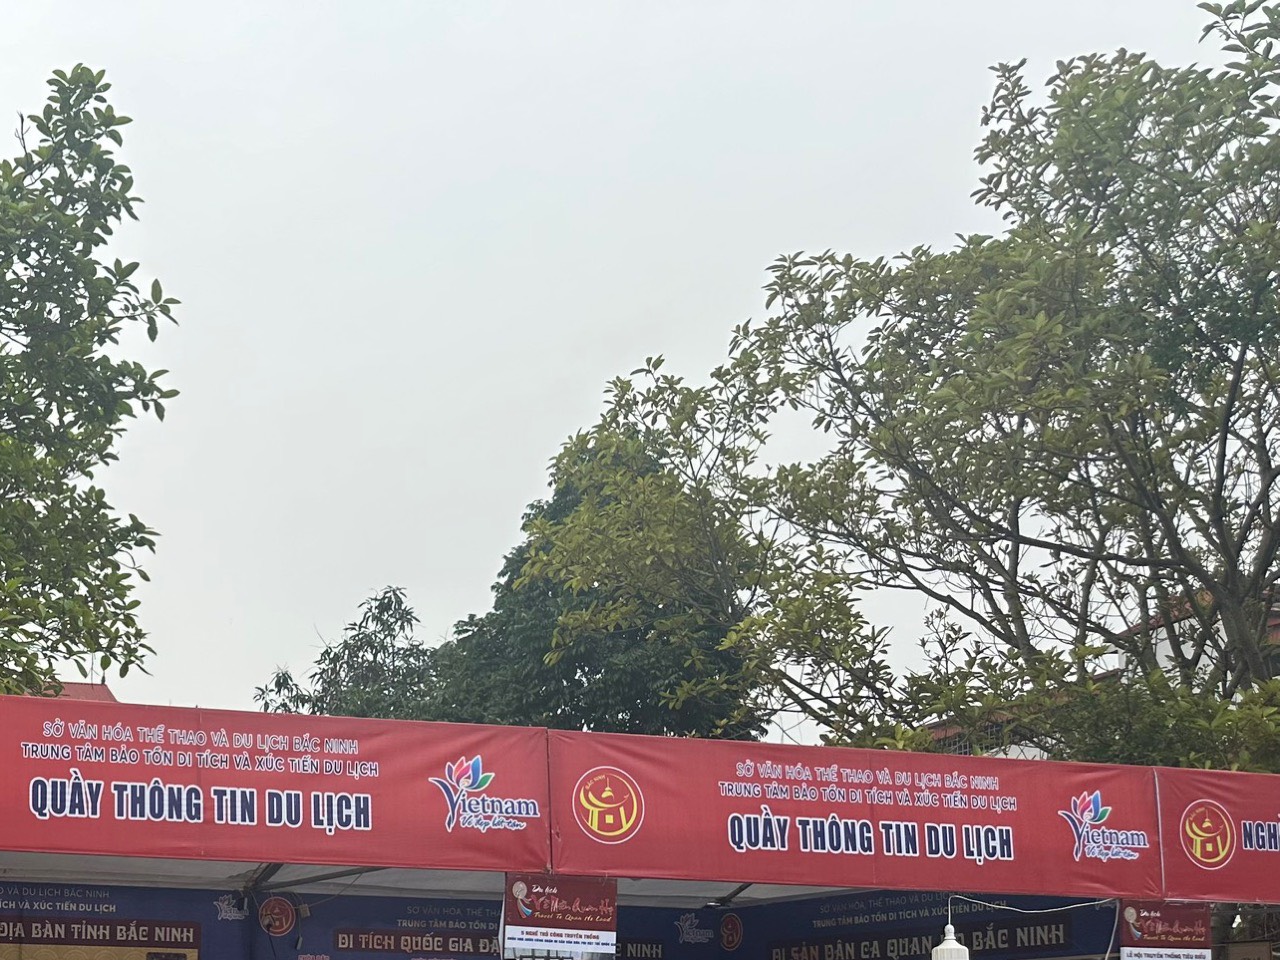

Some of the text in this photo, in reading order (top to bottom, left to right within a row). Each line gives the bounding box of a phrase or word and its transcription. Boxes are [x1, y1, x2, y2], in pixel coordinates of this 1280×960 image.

[43, 718, 359, 755] SỞ VĂN HÓA THỂ THAO VÀ DU LỊCH BẮC NINH
[21, 742, 379, 780] TRUNG TÂM BẢO TỒN DI TÍCH VÀ XÚC TIẾN DU LỊCH
[736, 759, 999, 791] SỞ VĂN HÓA THỂ THAO VÀ DU LỊCH BẮC NINH
[29, 768, 372, 835] QUẦY THÔNG TIN DU LỊCH
[428, 777, 540, 832] Vietnam
[719, 780, 1017, 814] TRUNG TÂM BẢO TỒN DI TÍCH VÀ XÚC TIẾN DU LỊCH
[728, 804, 1014, 865] QUẦY THÔNG TIN DU LỊCH
[1058, 810, 1149, 862] Vietnam
[1241, 819, 1280, 851] NGH
[18, 900, 31, 910] VÀ
[33, 900, 53, 911] XÚC
[55, 901, 77, 911] TIẾN
[78, 903, 93, 912] DU
[94, 903, 116, 914] LỊCH
[30, 918, 66, 940] BÀN
[70, 918, 111, 941] TỈNH
[115, 918, 150, 942] BẮC
[153, 924, 195, 943] NINH
[358, 931, 395, 950] TÍCH
[400, 931, 443, 953] QUỐC
[448, 937, 474, 952] GIA
[479, 935, 500, 956] ĐẶ
[972, 922, 1065, 950] BẮC NINH
[626, 943, 663, 959] NINH
[860, 940, 881, 959] CA
[887, 935, 933, 960] QUAN
